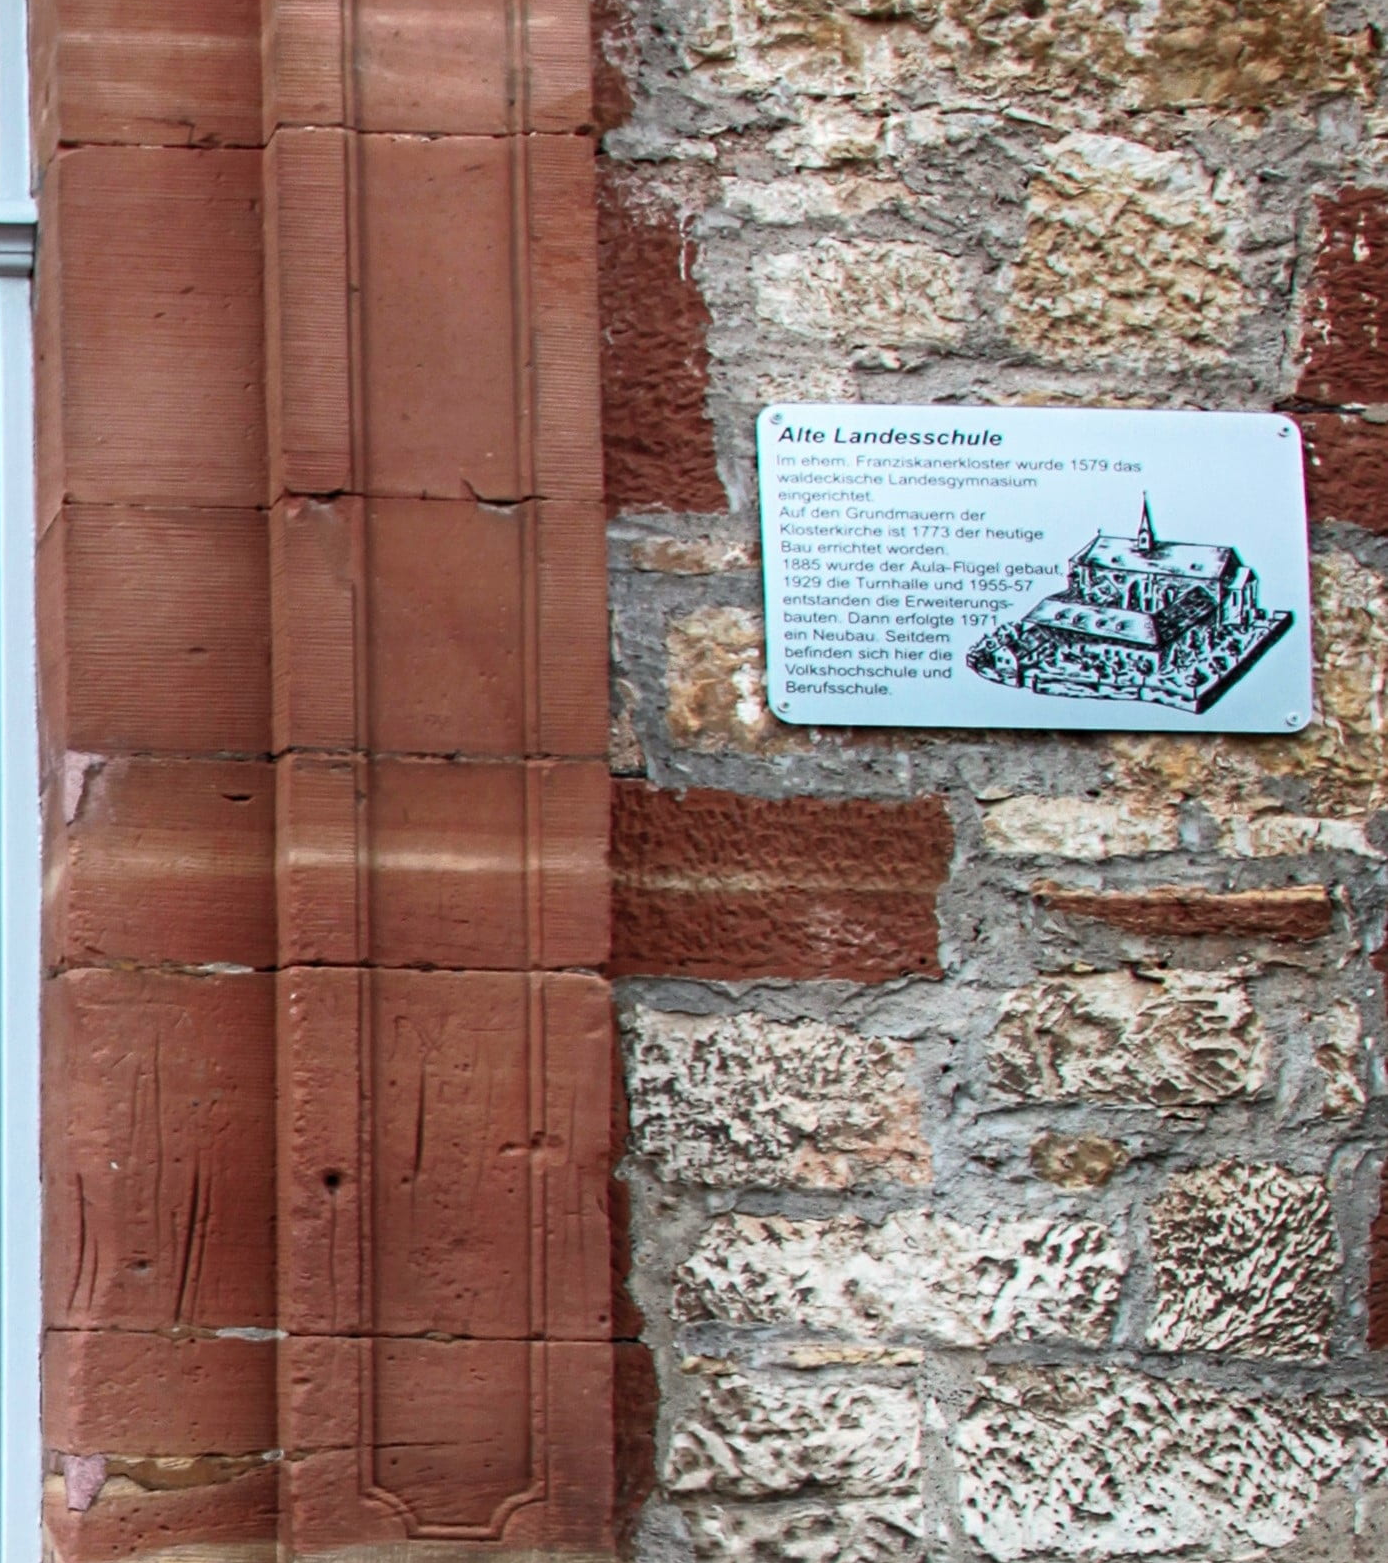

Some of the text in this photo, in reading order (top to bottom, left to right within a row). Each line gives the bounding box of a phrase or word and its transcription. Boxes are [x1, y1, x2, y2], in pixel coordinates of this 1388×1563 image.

[778, 427, 1003, 446] Alte Landesschule
[777, 455, 1142, 474] Im ehem. Franziskanerkloster wurde 1579 das
[777, 473, 1037, 488] waldeckische Landesgymnasium
[778, 490, 874, 505] eingerichtet.
[779, 507, 986, 521] Auf den Grundmauern der
[780, 525, 1043, 541] Klosterkirche ist 1773 der heutige
[781, 541, 948, 555] Bau errichtet worden.
[783, 559, 821, 570] 1885
[825, 560, 874, 572] wurde
[879, 561, 905, 572] der
[910, 561, 1000, 575] Aula-Flügel
[784, 577, 1033, 591] 1929 die Turnhalle und 1955-57
[783, 594, 1013, 611] entstanden die Erweiterungs-
[784, 612, 997, 628] bauten. Dann erfolgte 1971
[784, 629, 807, 641] ein
[885, 631, 950, 643] Seitdem
[785, 646, 952, 661] befinden sich hier die
[785, 664, 952, 679] Volkshochschule und
[786, 682, 892, 696] Berufsschule.
